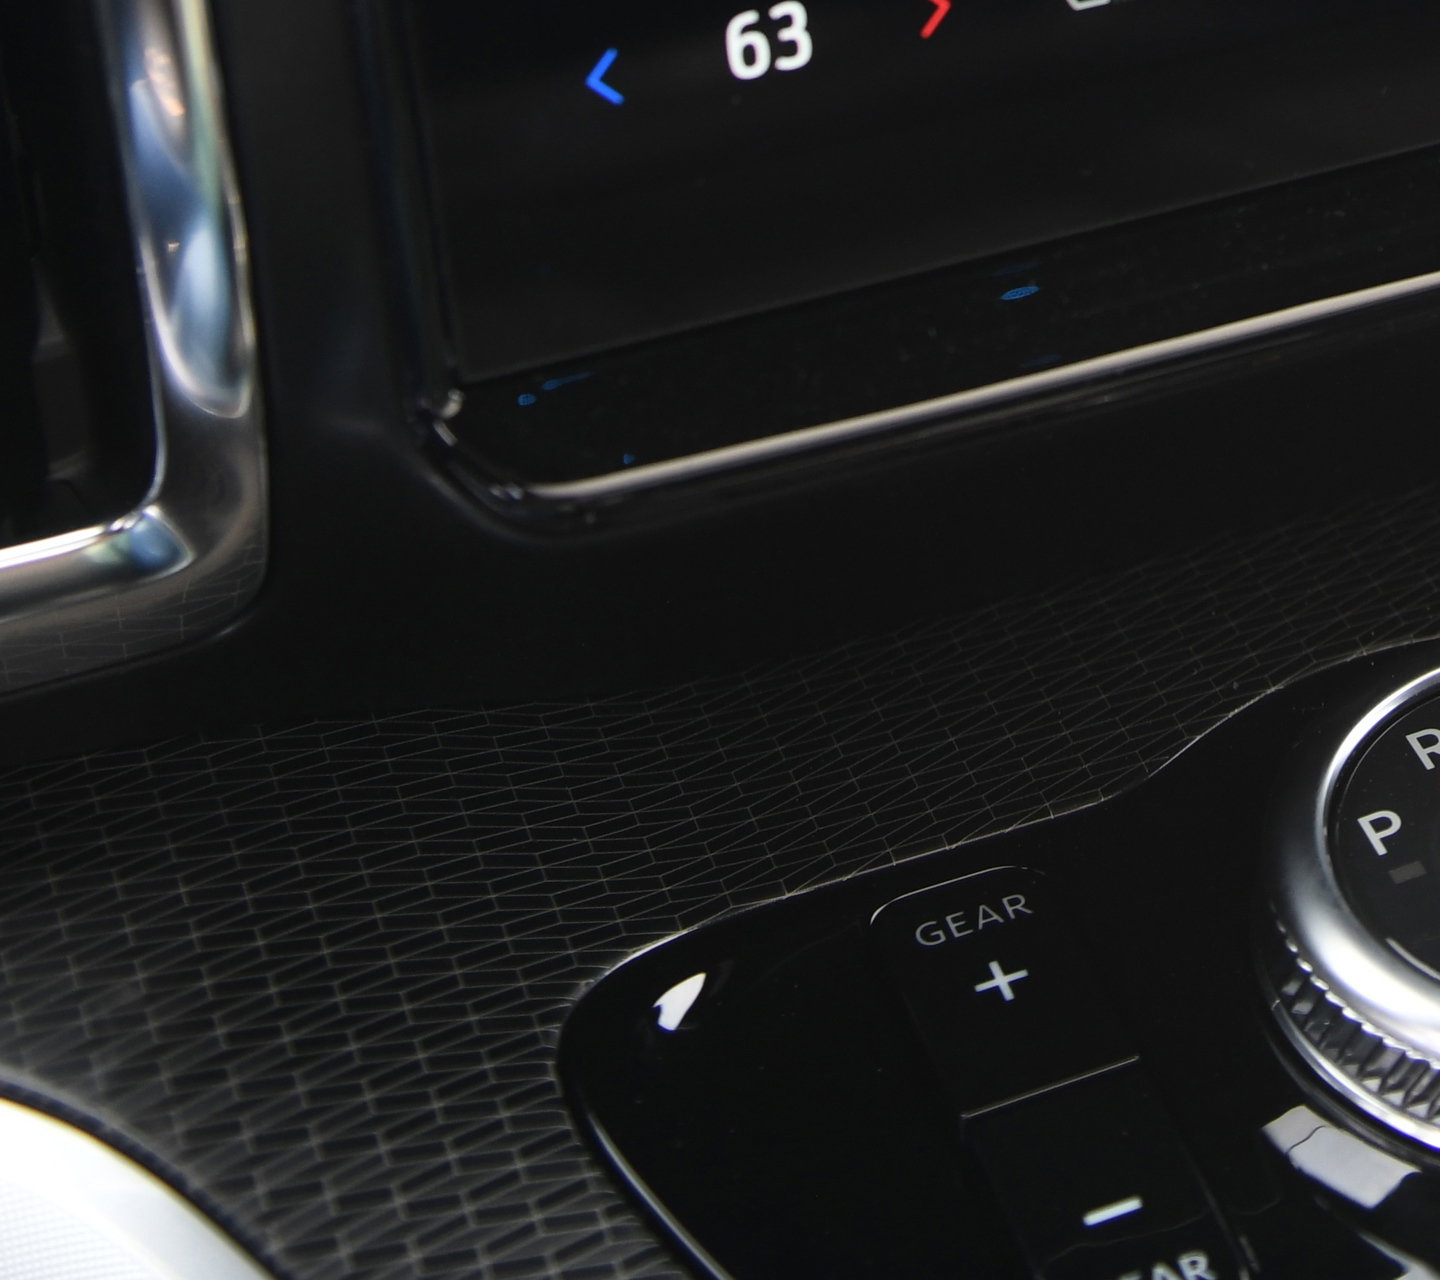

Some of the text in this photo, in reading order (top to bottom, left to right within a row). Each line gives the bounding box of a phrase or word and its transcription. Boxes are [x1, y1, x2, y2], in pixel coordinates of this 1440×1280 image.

[726, 0, 813, 79] 63
[1357, 810, 1402, 856] P
[915, 893, 1034, 948] GEAR
